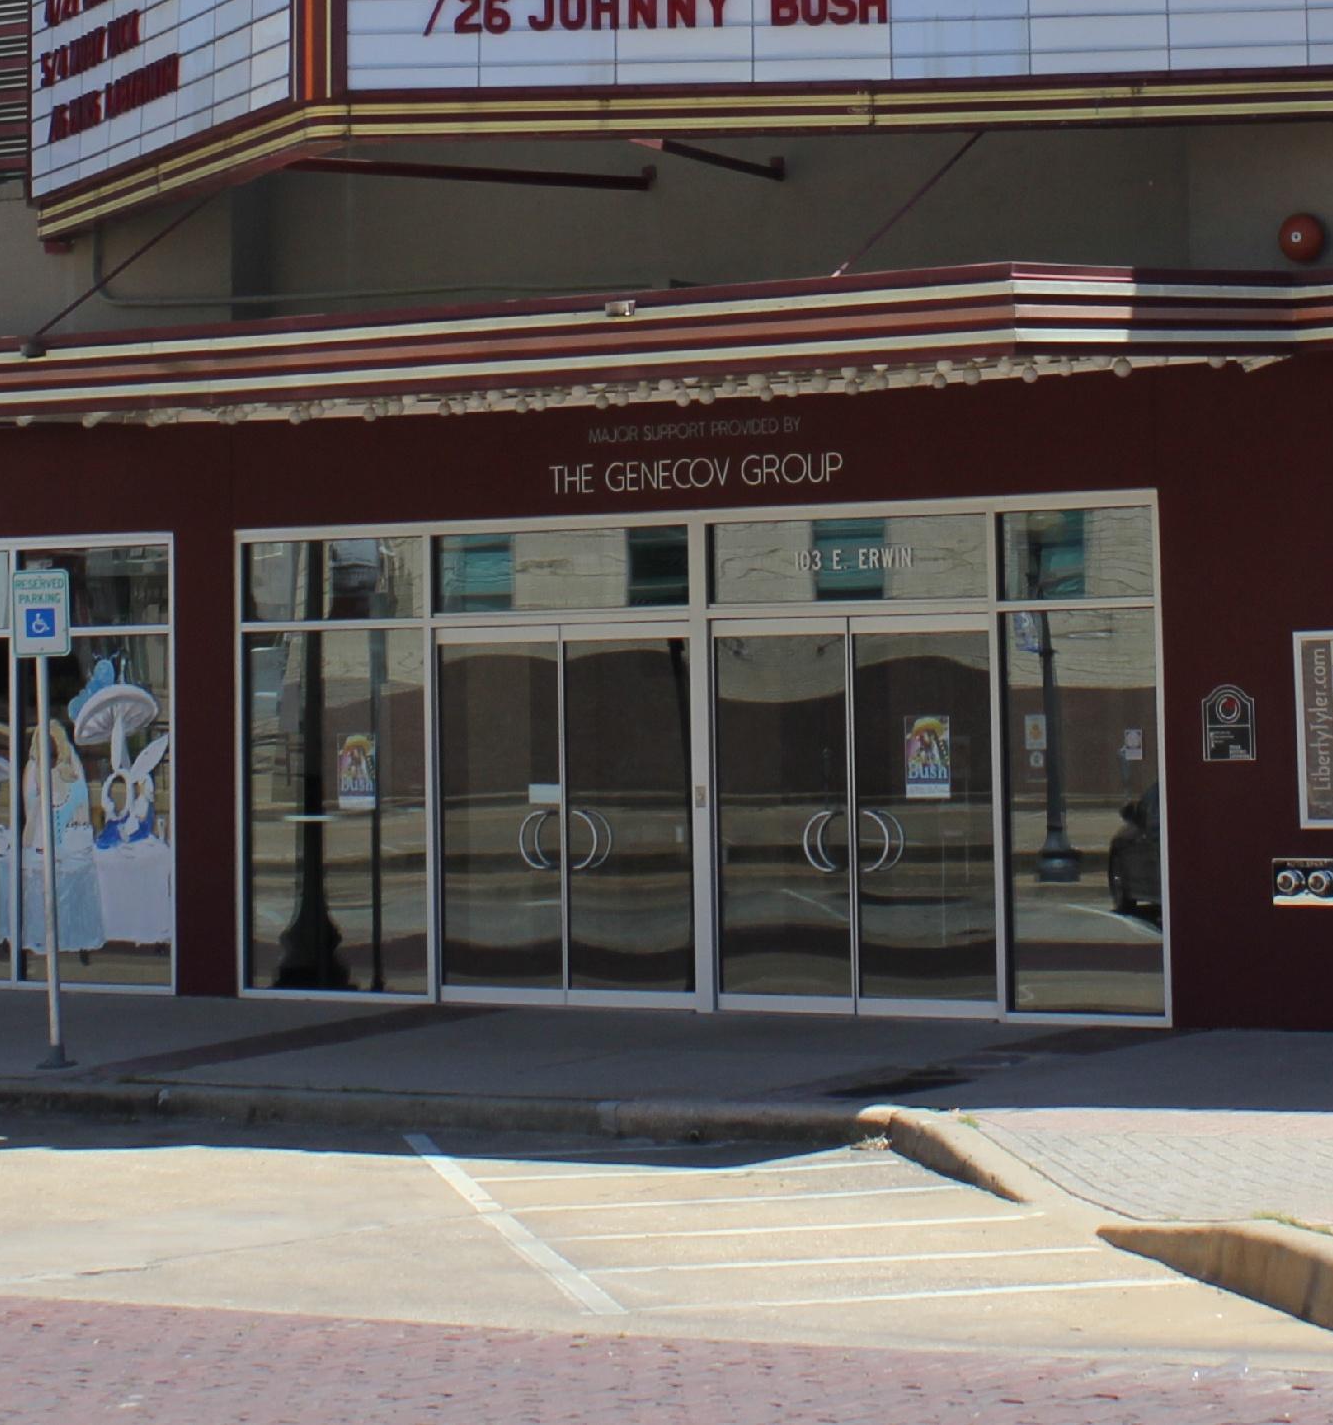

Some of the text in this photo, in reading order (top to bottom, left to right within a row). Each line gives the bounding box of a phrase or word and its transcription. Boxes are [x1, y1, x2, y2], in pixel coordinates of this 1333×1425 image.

[588, 416, 801, 444] MAJOR SUPPORT PROVIDED BY
[549, 452, 844, 495] THE GENECOV GROUP
[795, 550, 822, 571] 103
[858, 547, 914, 569] ERWIN
[14, 577, 65, 590] RESERVED
[18, 592, 61, 604] PARKING
[907, 761, 949, 780] Bush
[341, 775, 374, 792] Bush
